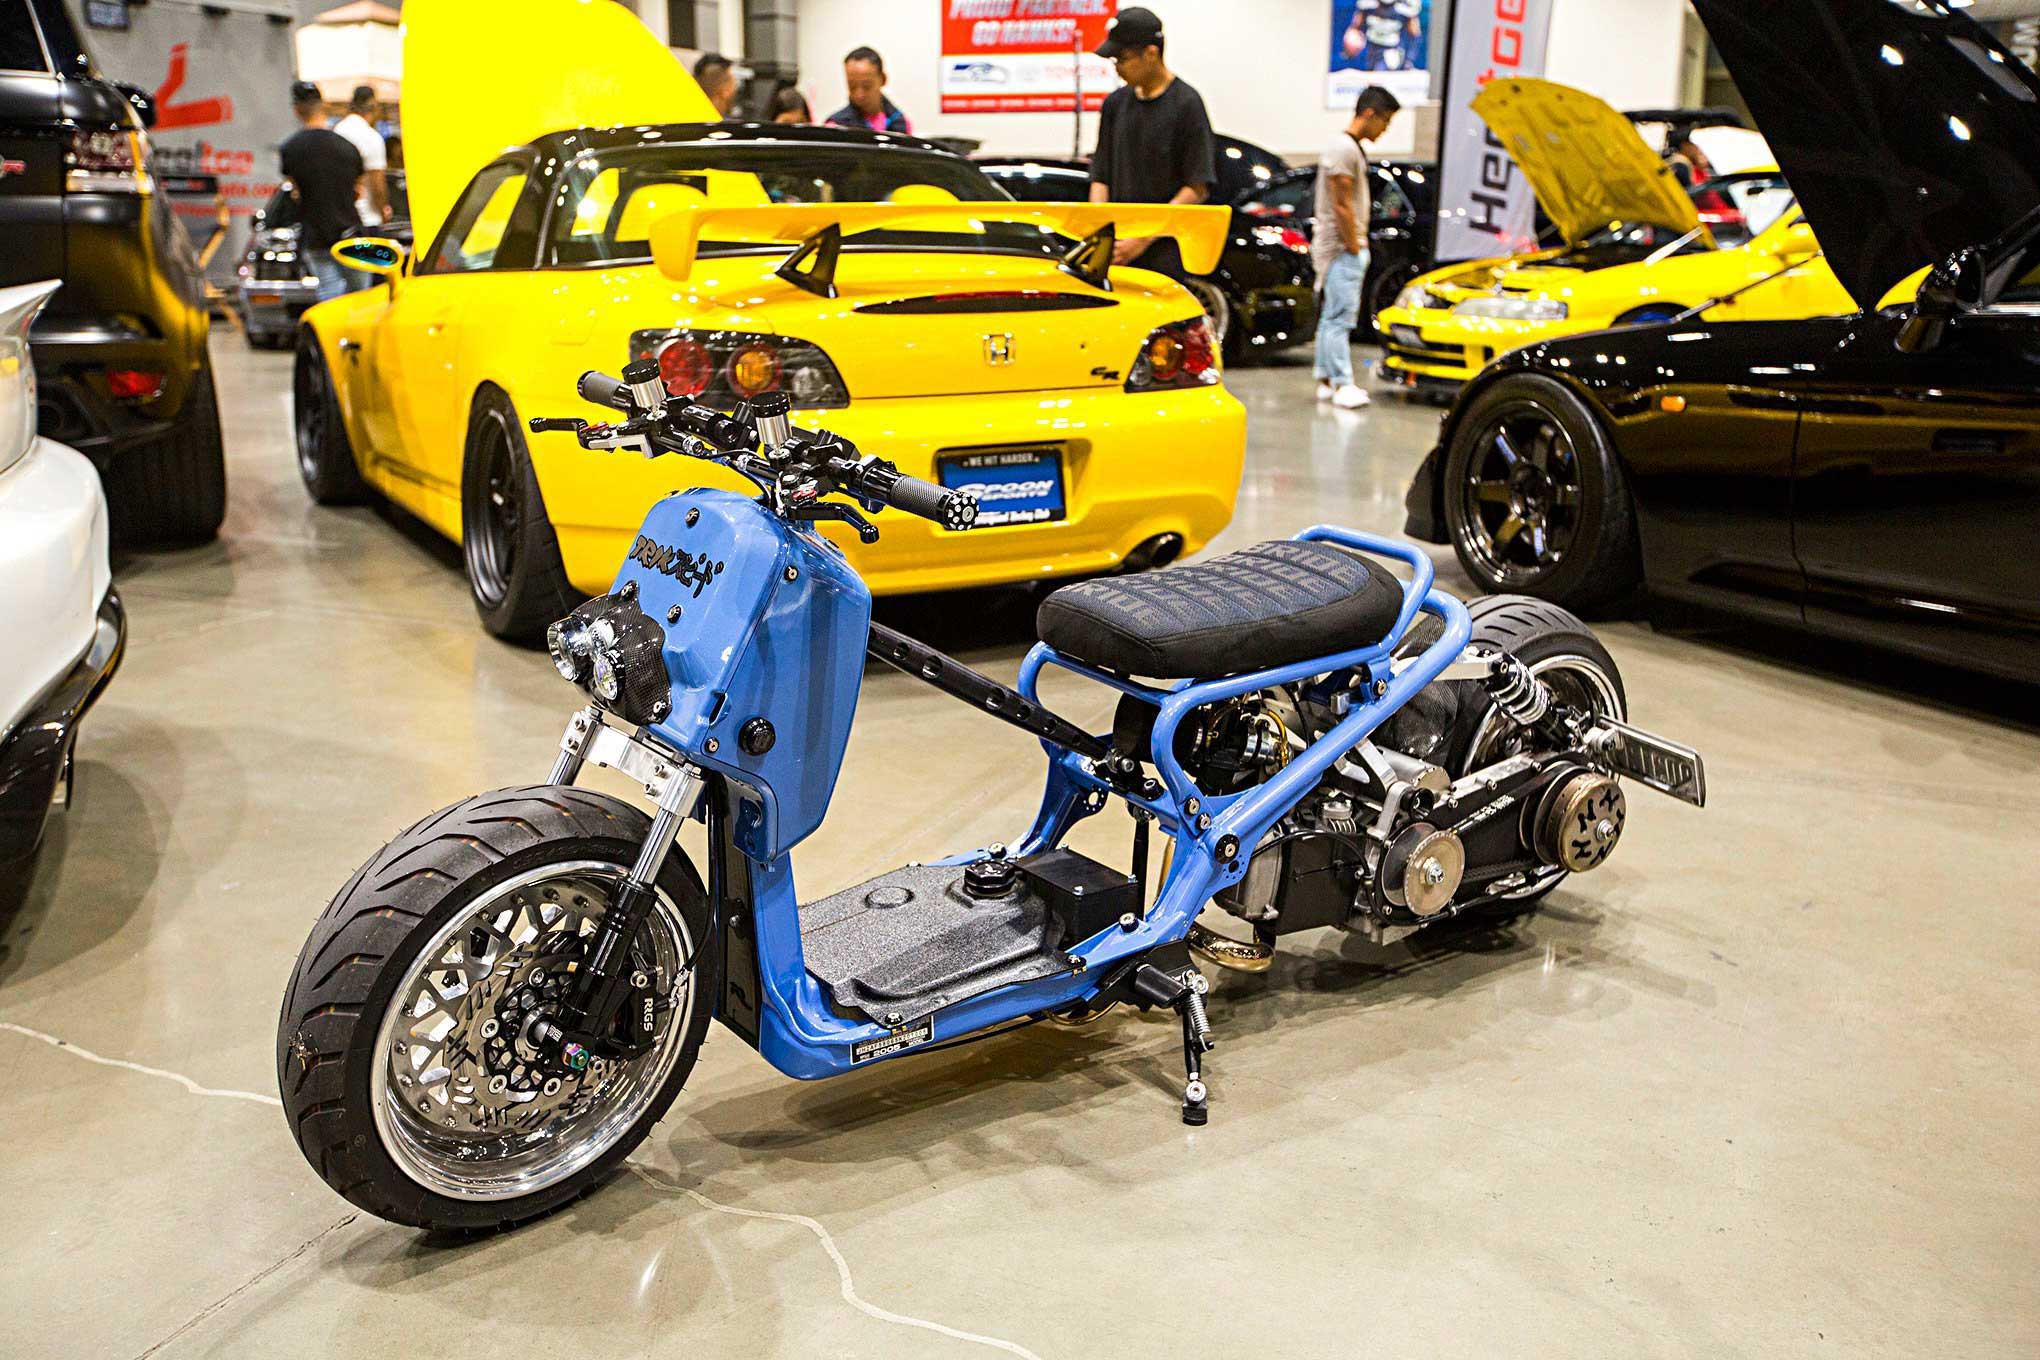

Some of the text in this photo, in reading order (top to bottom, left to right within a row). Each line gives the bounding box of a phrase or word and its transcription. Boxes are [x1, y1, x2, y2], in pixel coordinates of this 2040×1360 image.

[968, 452, 1034, 467] WE HIT HARDER
[956, 480, 1055, 499] SPOON
[873, 1044, 901, 1057] 2005
